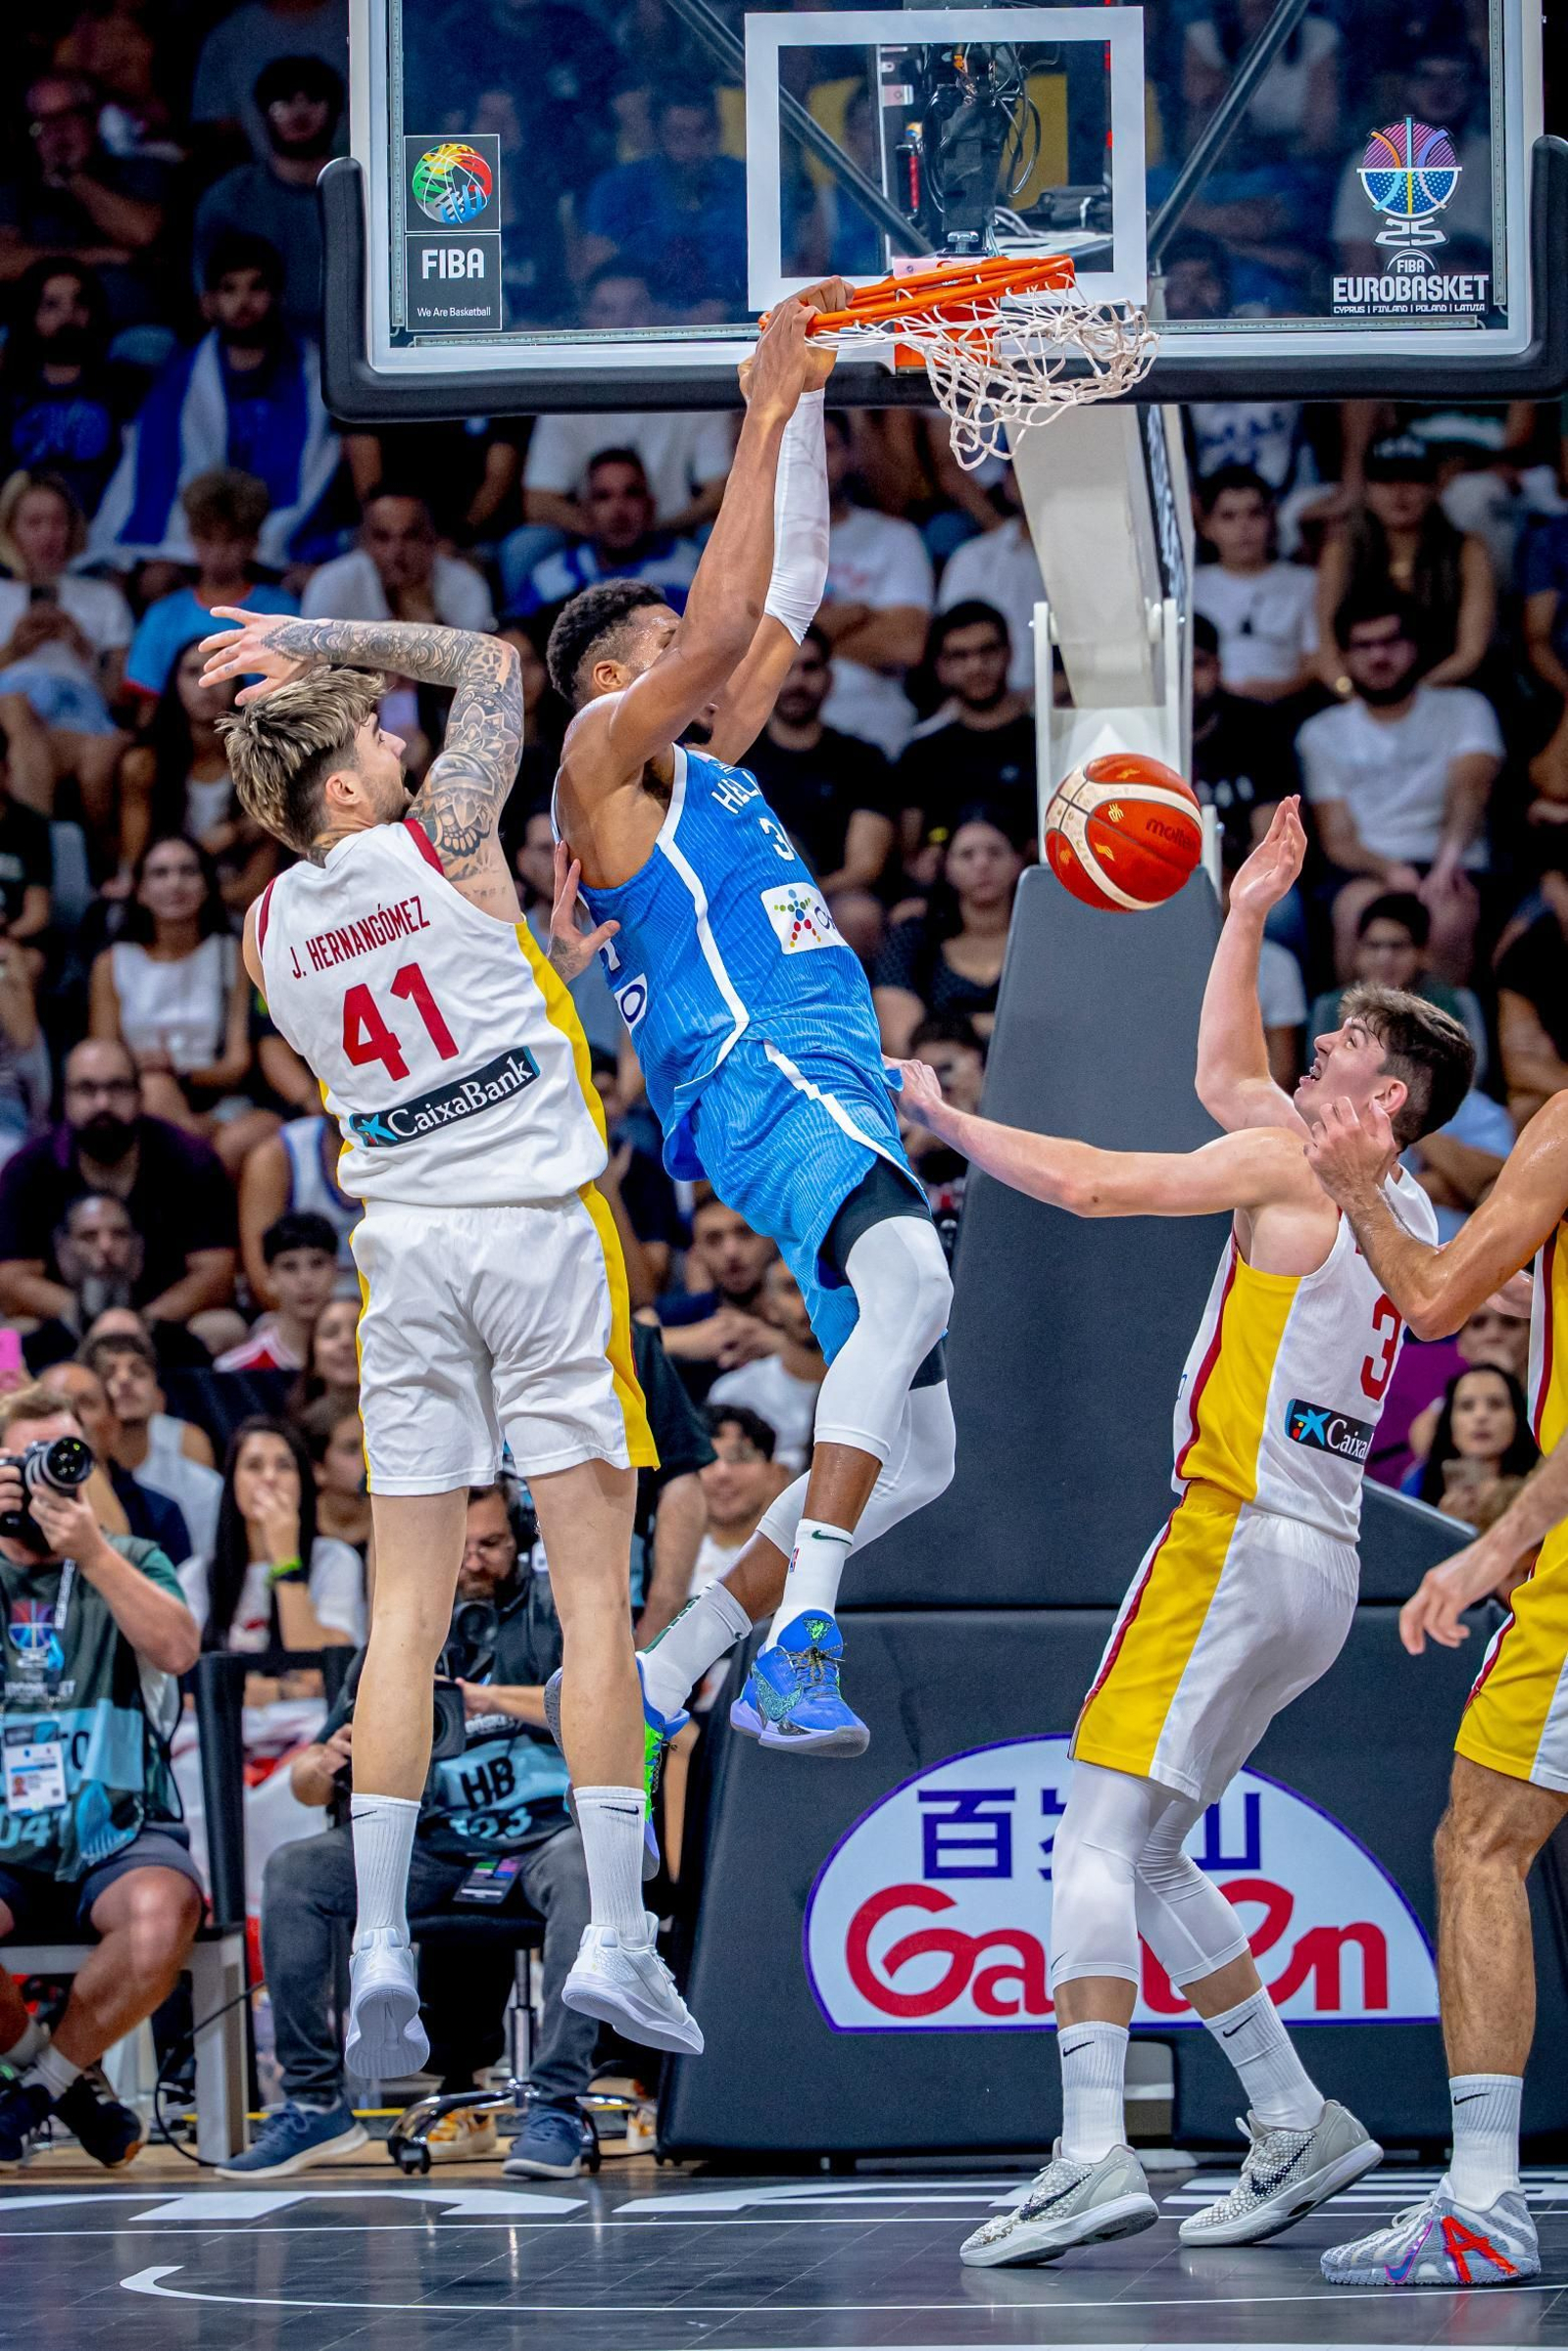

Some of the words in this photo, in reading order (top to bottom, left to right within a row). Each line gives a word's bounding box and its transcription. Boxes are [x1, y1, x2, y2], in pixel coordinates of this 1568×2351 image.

[421, 248, 485, 279] FIBA
[1333, 274, 1489, 303] EUROBASKET
[1396, 259, 1425, 273] FIBA
[416, 307, 431, 318] We
[433, 307, 448, 317] Are
[449, 306, 491, 317] Basketball
[1333, 305, 1365, 314] CYPRUS
[1372, 305, 1408, 314] FINLAND
[1415, 304, 1447, 313] POLAND
[1454, 303, 1485, 312] LATVIA
[759, 816, 796, 861] 3
[290, 946, 307, 979] J.
[305, 895, 431, 972] HERNANGÓMEZ
[343, 961, 460, 1082] 41
[387, 1056, 533, 1138] CaixaBank
[1360, 1293, 1405, 1402] 3
[1326, 1417, 1375, 1460] Caixa
[460, 1756, 515, 1812] HB
[917, 1788, 1261, 1881] 百山
[845, 1878, 1389, 2018] Gaen
